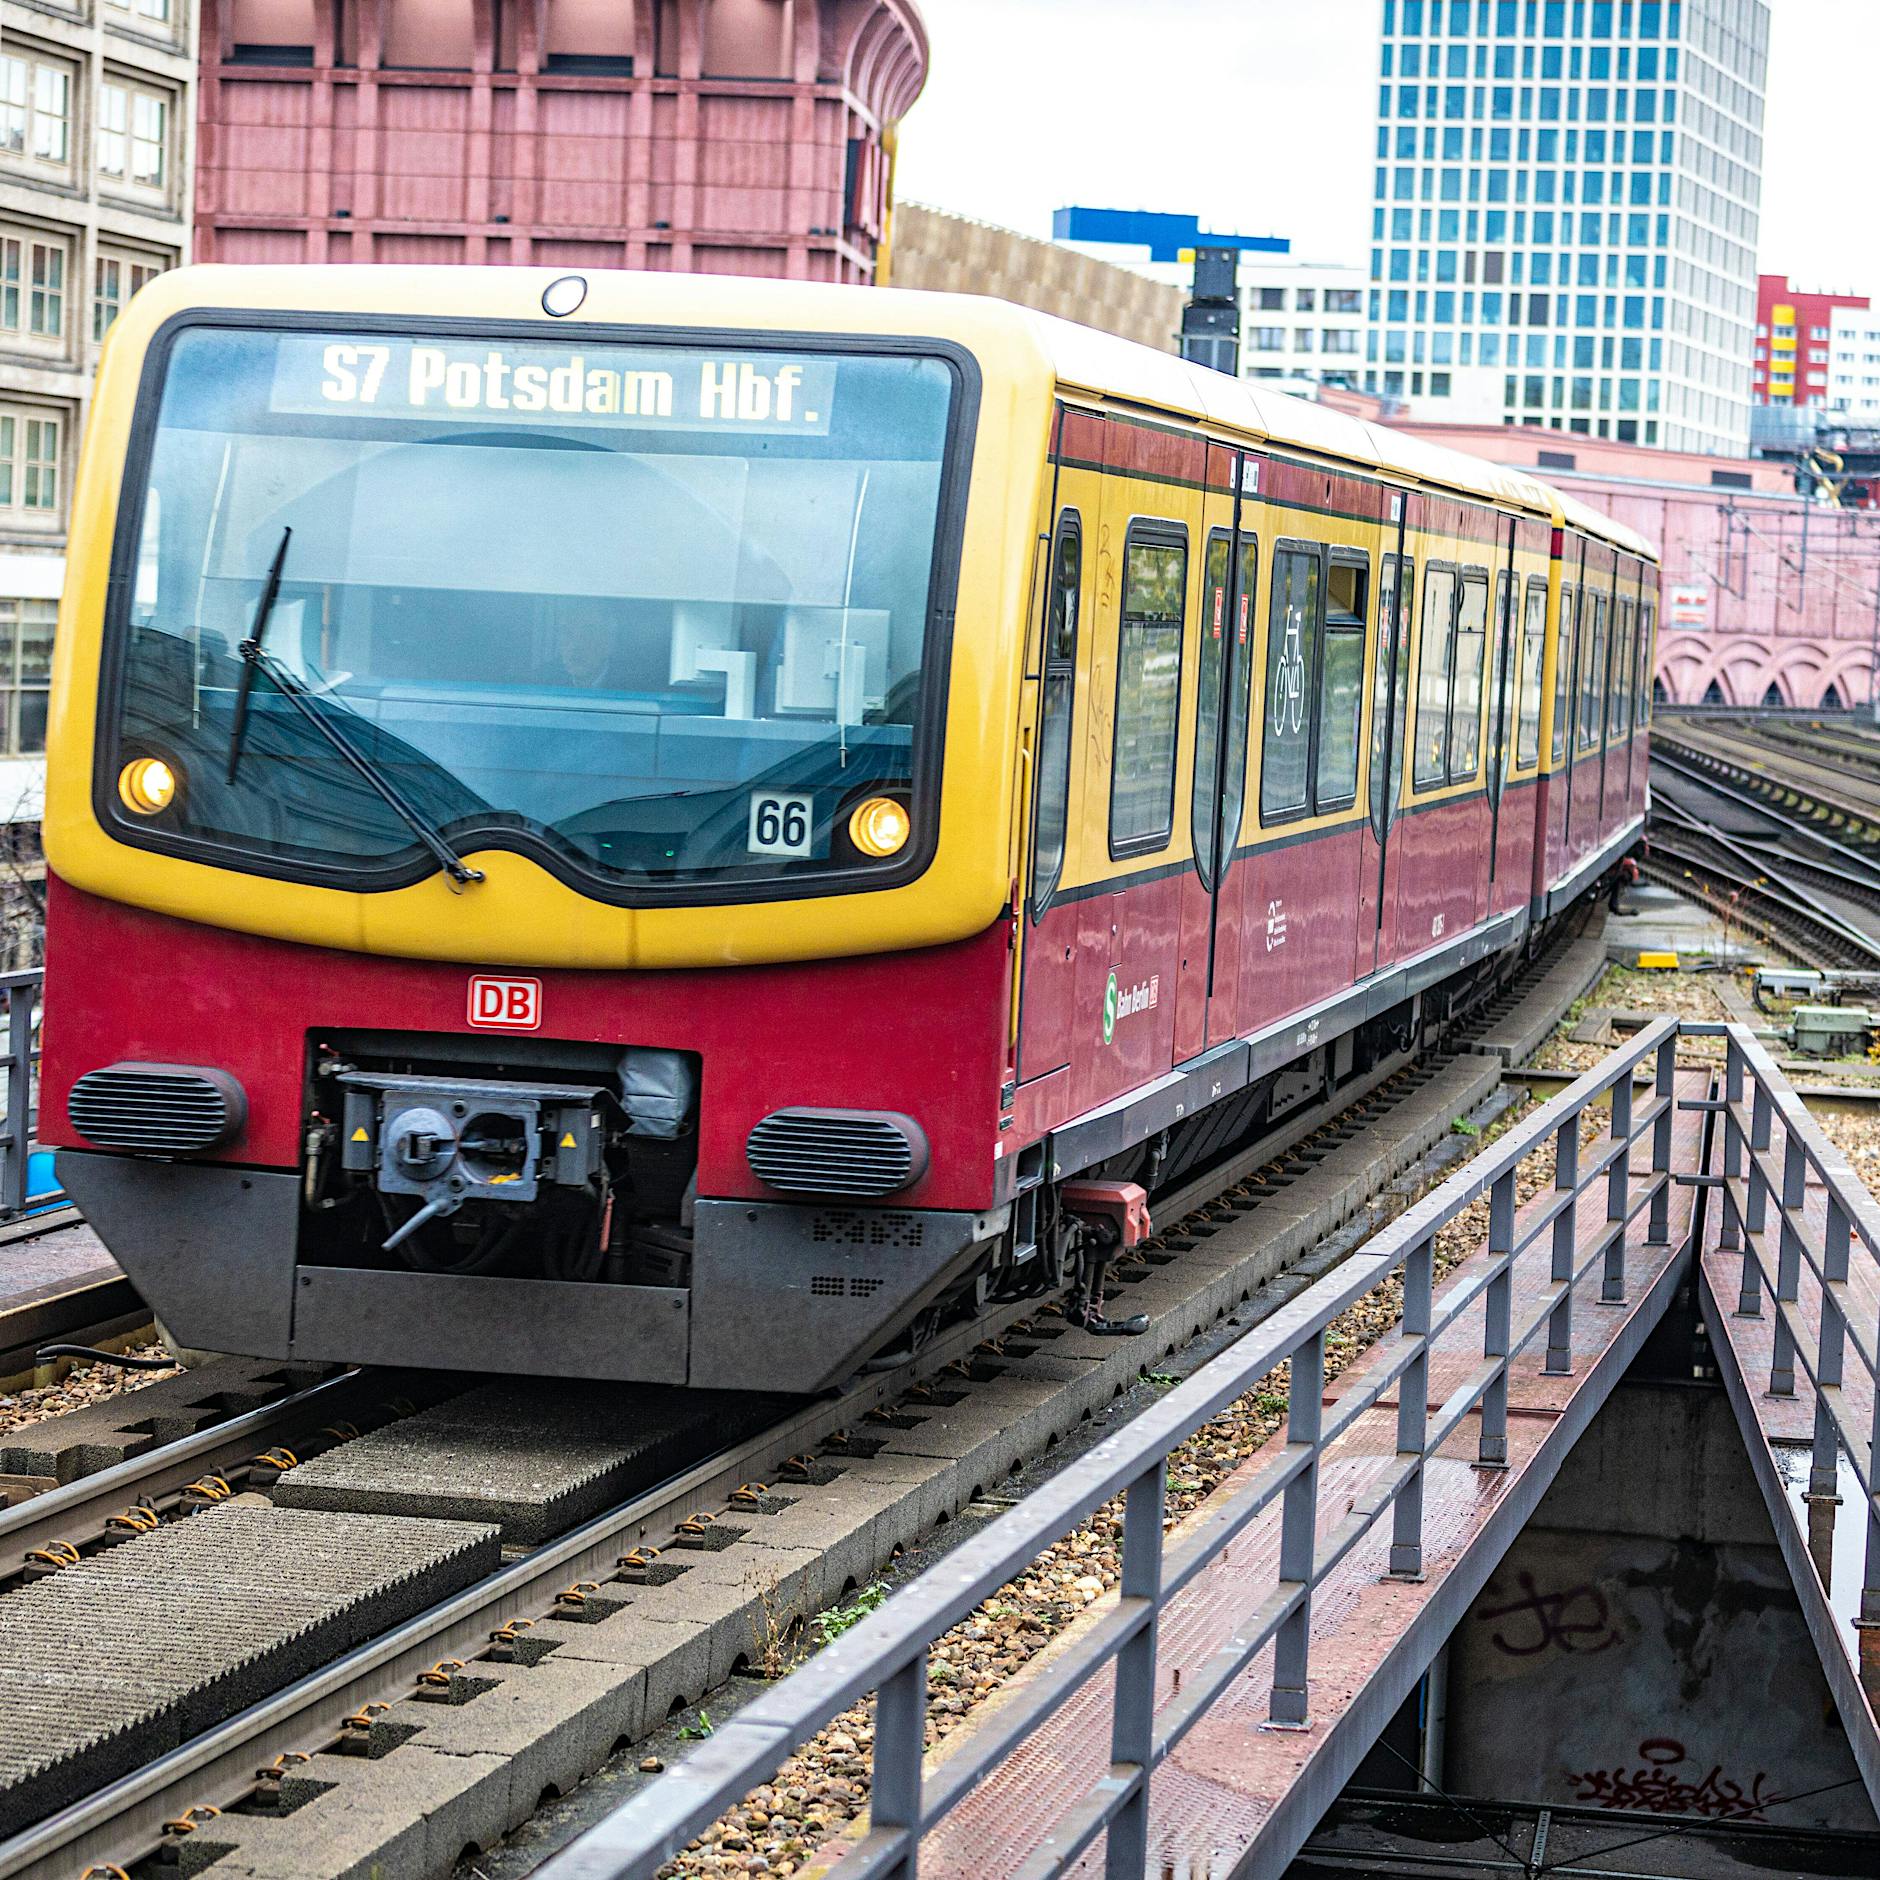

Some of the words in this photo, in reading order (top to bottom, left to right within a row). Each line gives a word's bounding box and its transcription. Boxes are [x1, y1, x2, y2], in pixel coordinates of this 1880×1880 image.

[321, 344, 390, 403] S7
[409, 346, 673, 418] Potsdam
[700, 360, 819, 423] Hbf.
[756, 799, 806, 847] 66
[479, 984, 530, 1020] DB
